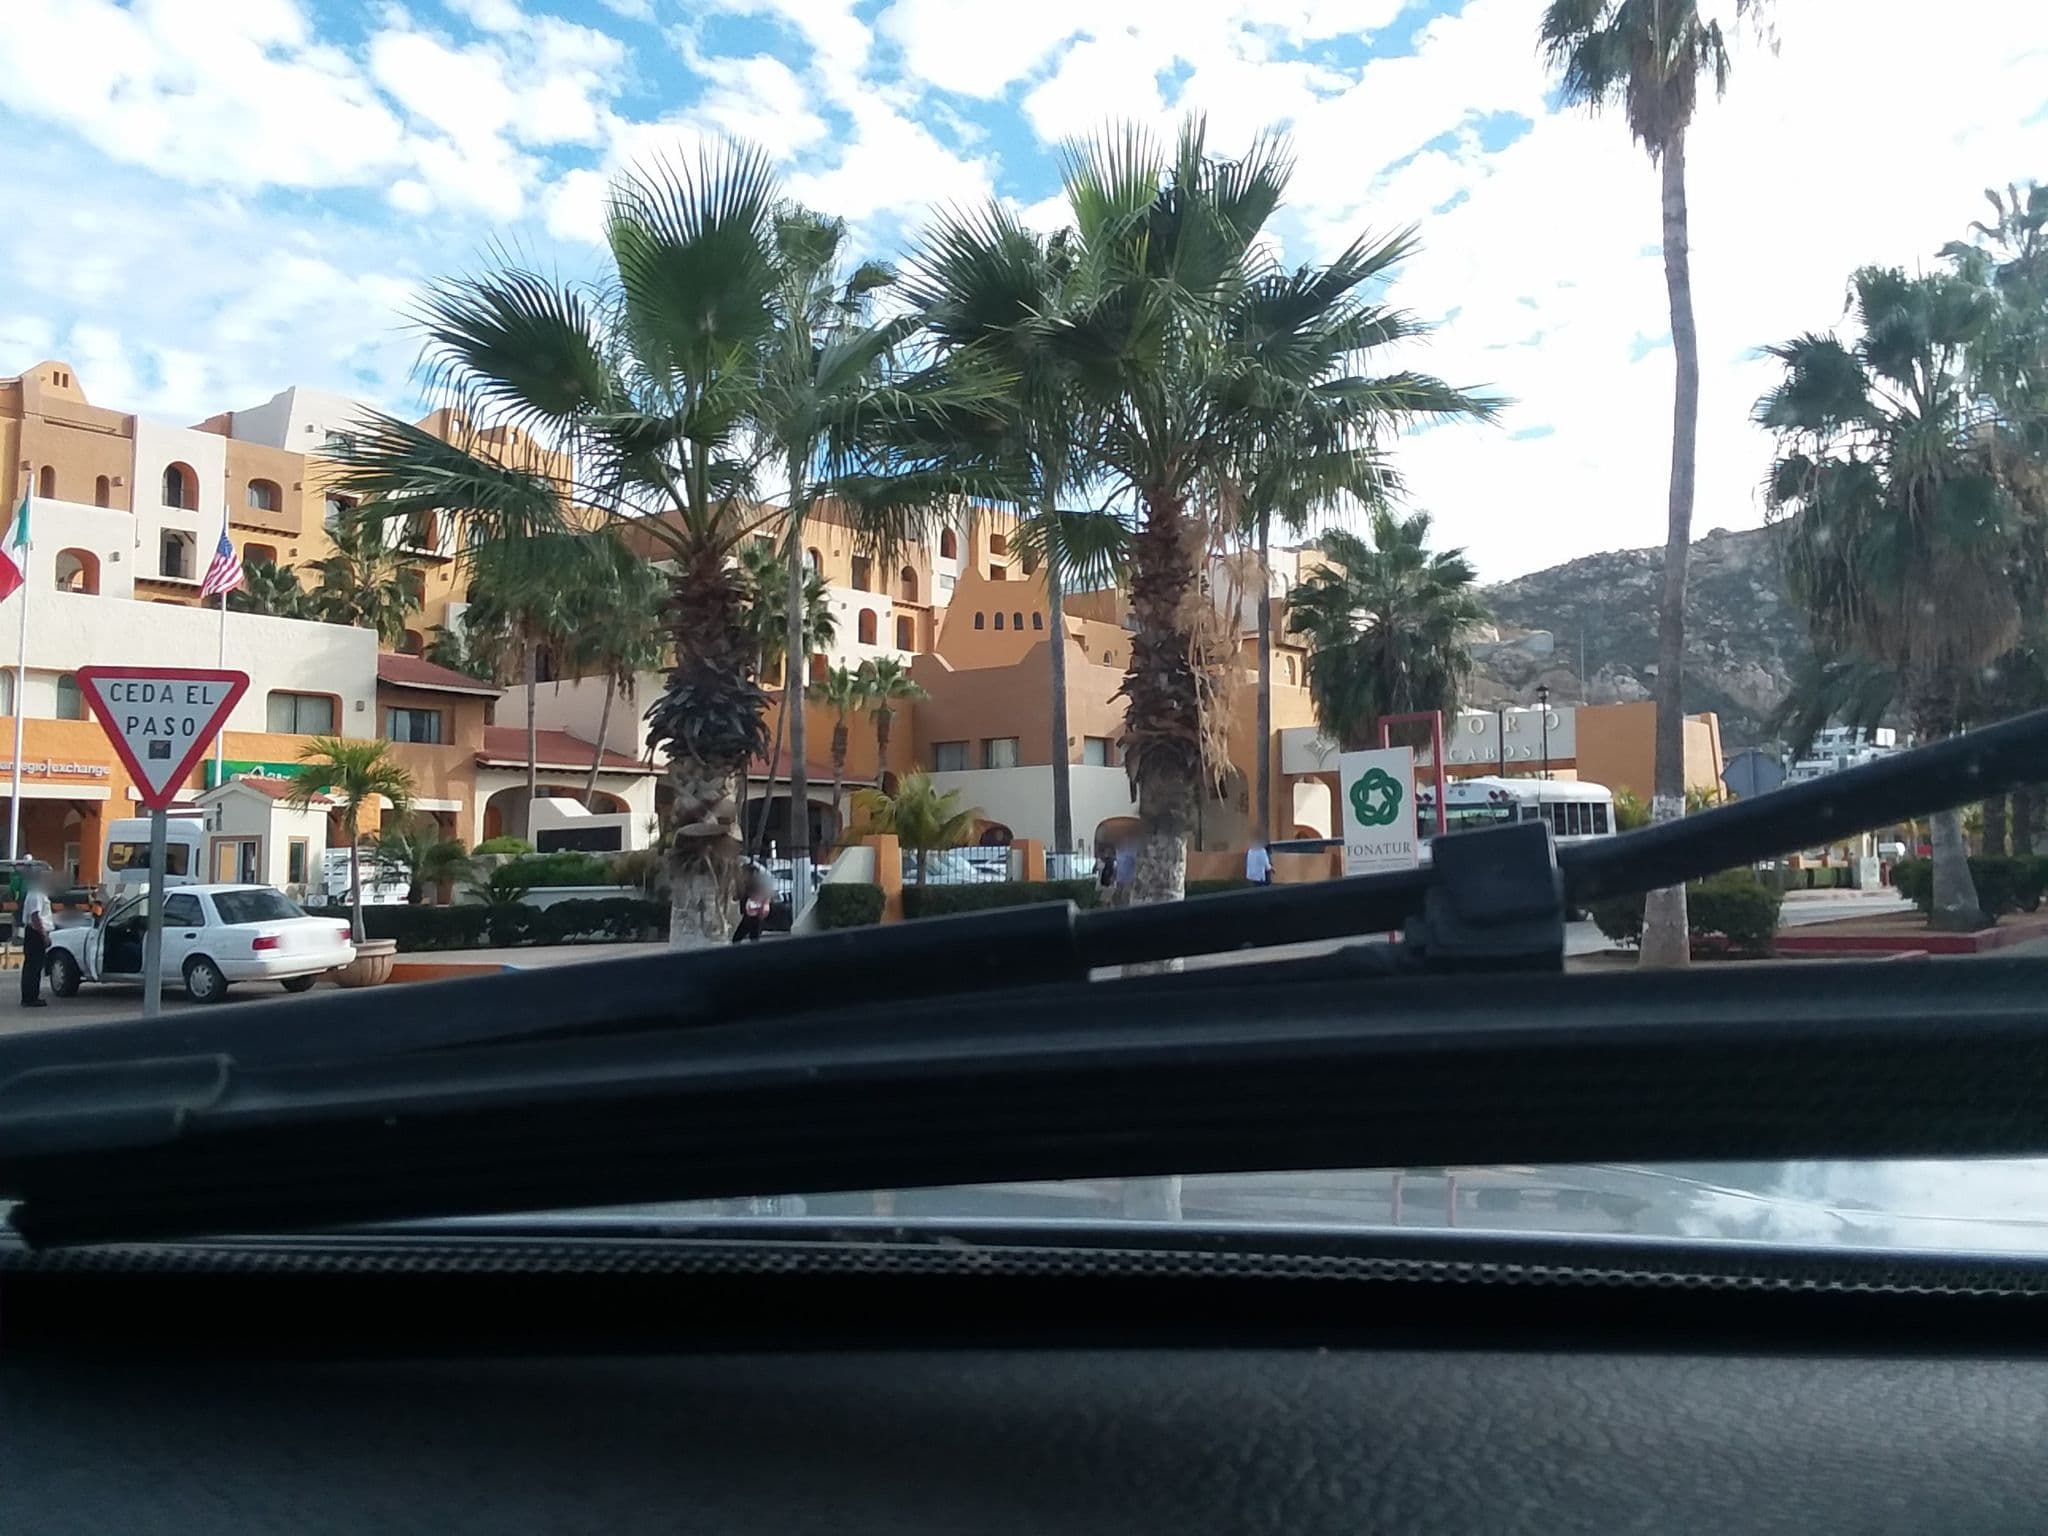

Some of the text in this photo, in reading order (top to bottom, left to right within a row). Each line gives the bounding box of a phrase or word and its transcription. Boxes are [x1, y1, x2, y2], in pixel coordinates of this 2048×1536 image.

[110, 683, 214, 705] CEDA EL
[126, 716, 195, 737] PASO
[1449, 745, 1532, 761] CABOS
[1346, 841, 1412, 857] FONATUR
